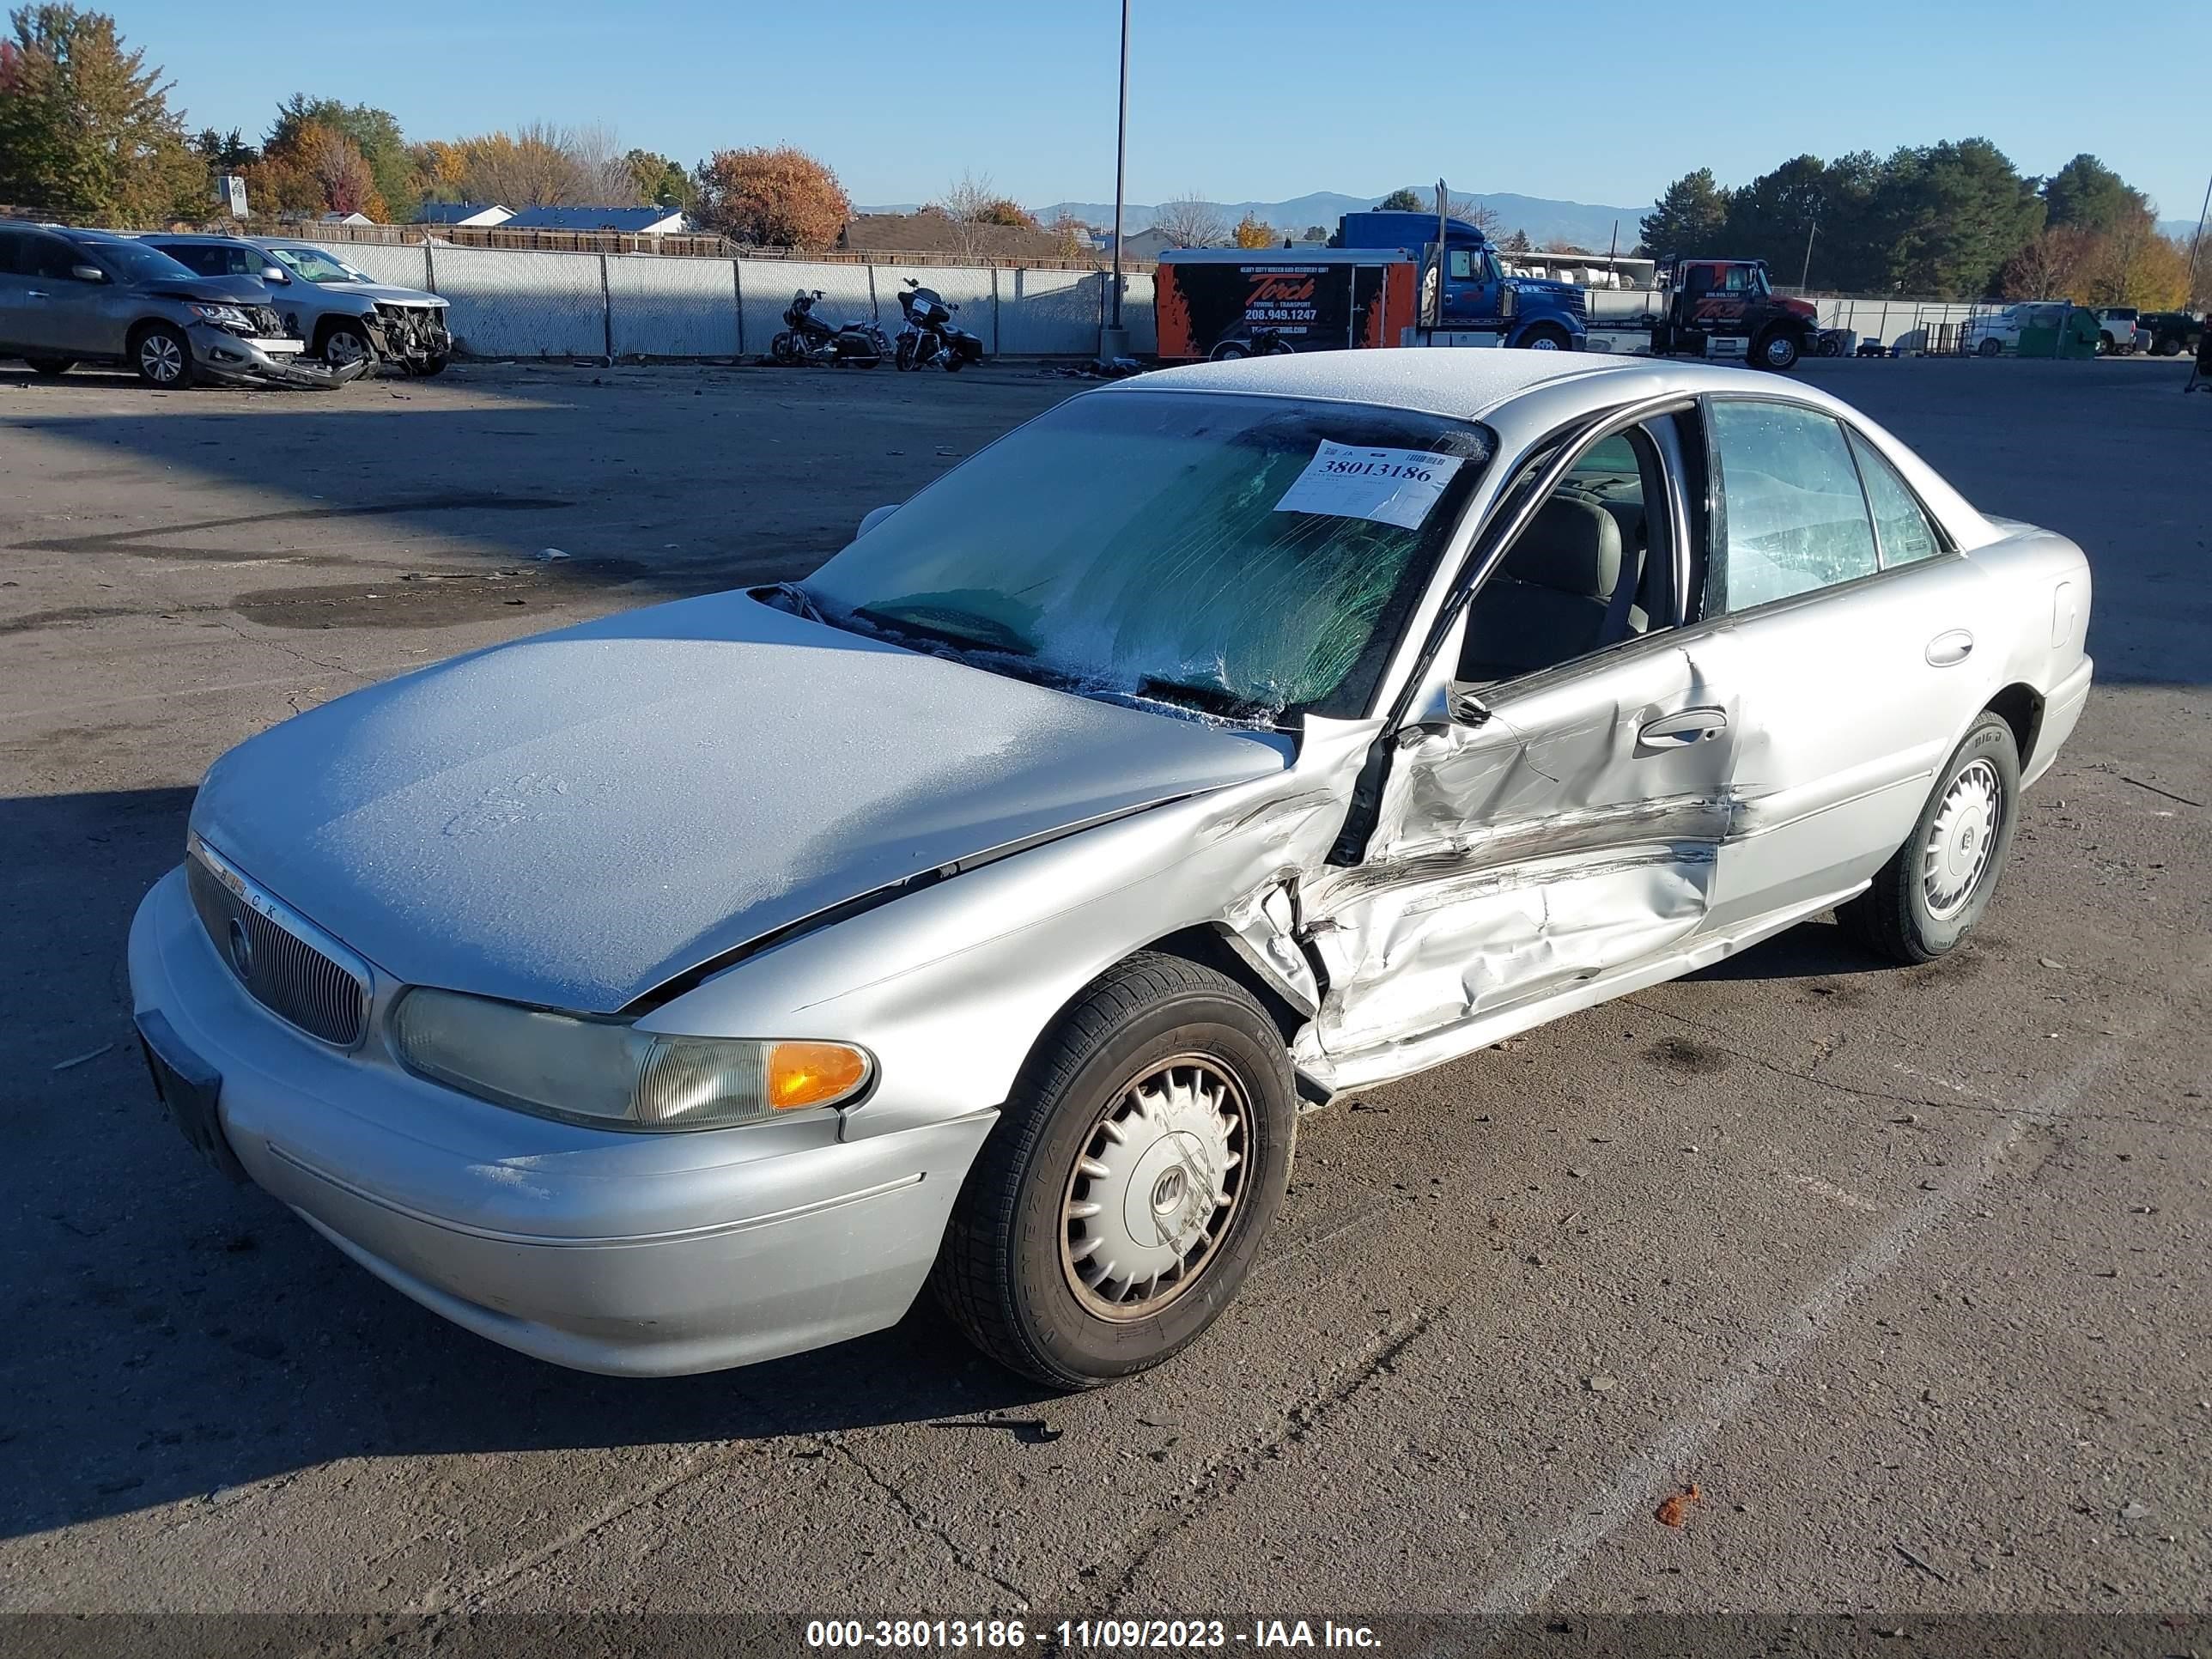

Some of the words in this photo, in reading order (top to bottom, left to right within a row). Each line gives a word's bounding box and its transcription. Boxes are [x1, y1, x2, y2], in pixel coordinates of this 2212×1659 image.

[1245, 309, 1317, 320] 208.949.1247
[1318, 460, 1437, 483] 38013186
[218, 868, 277, 919] BUICK
